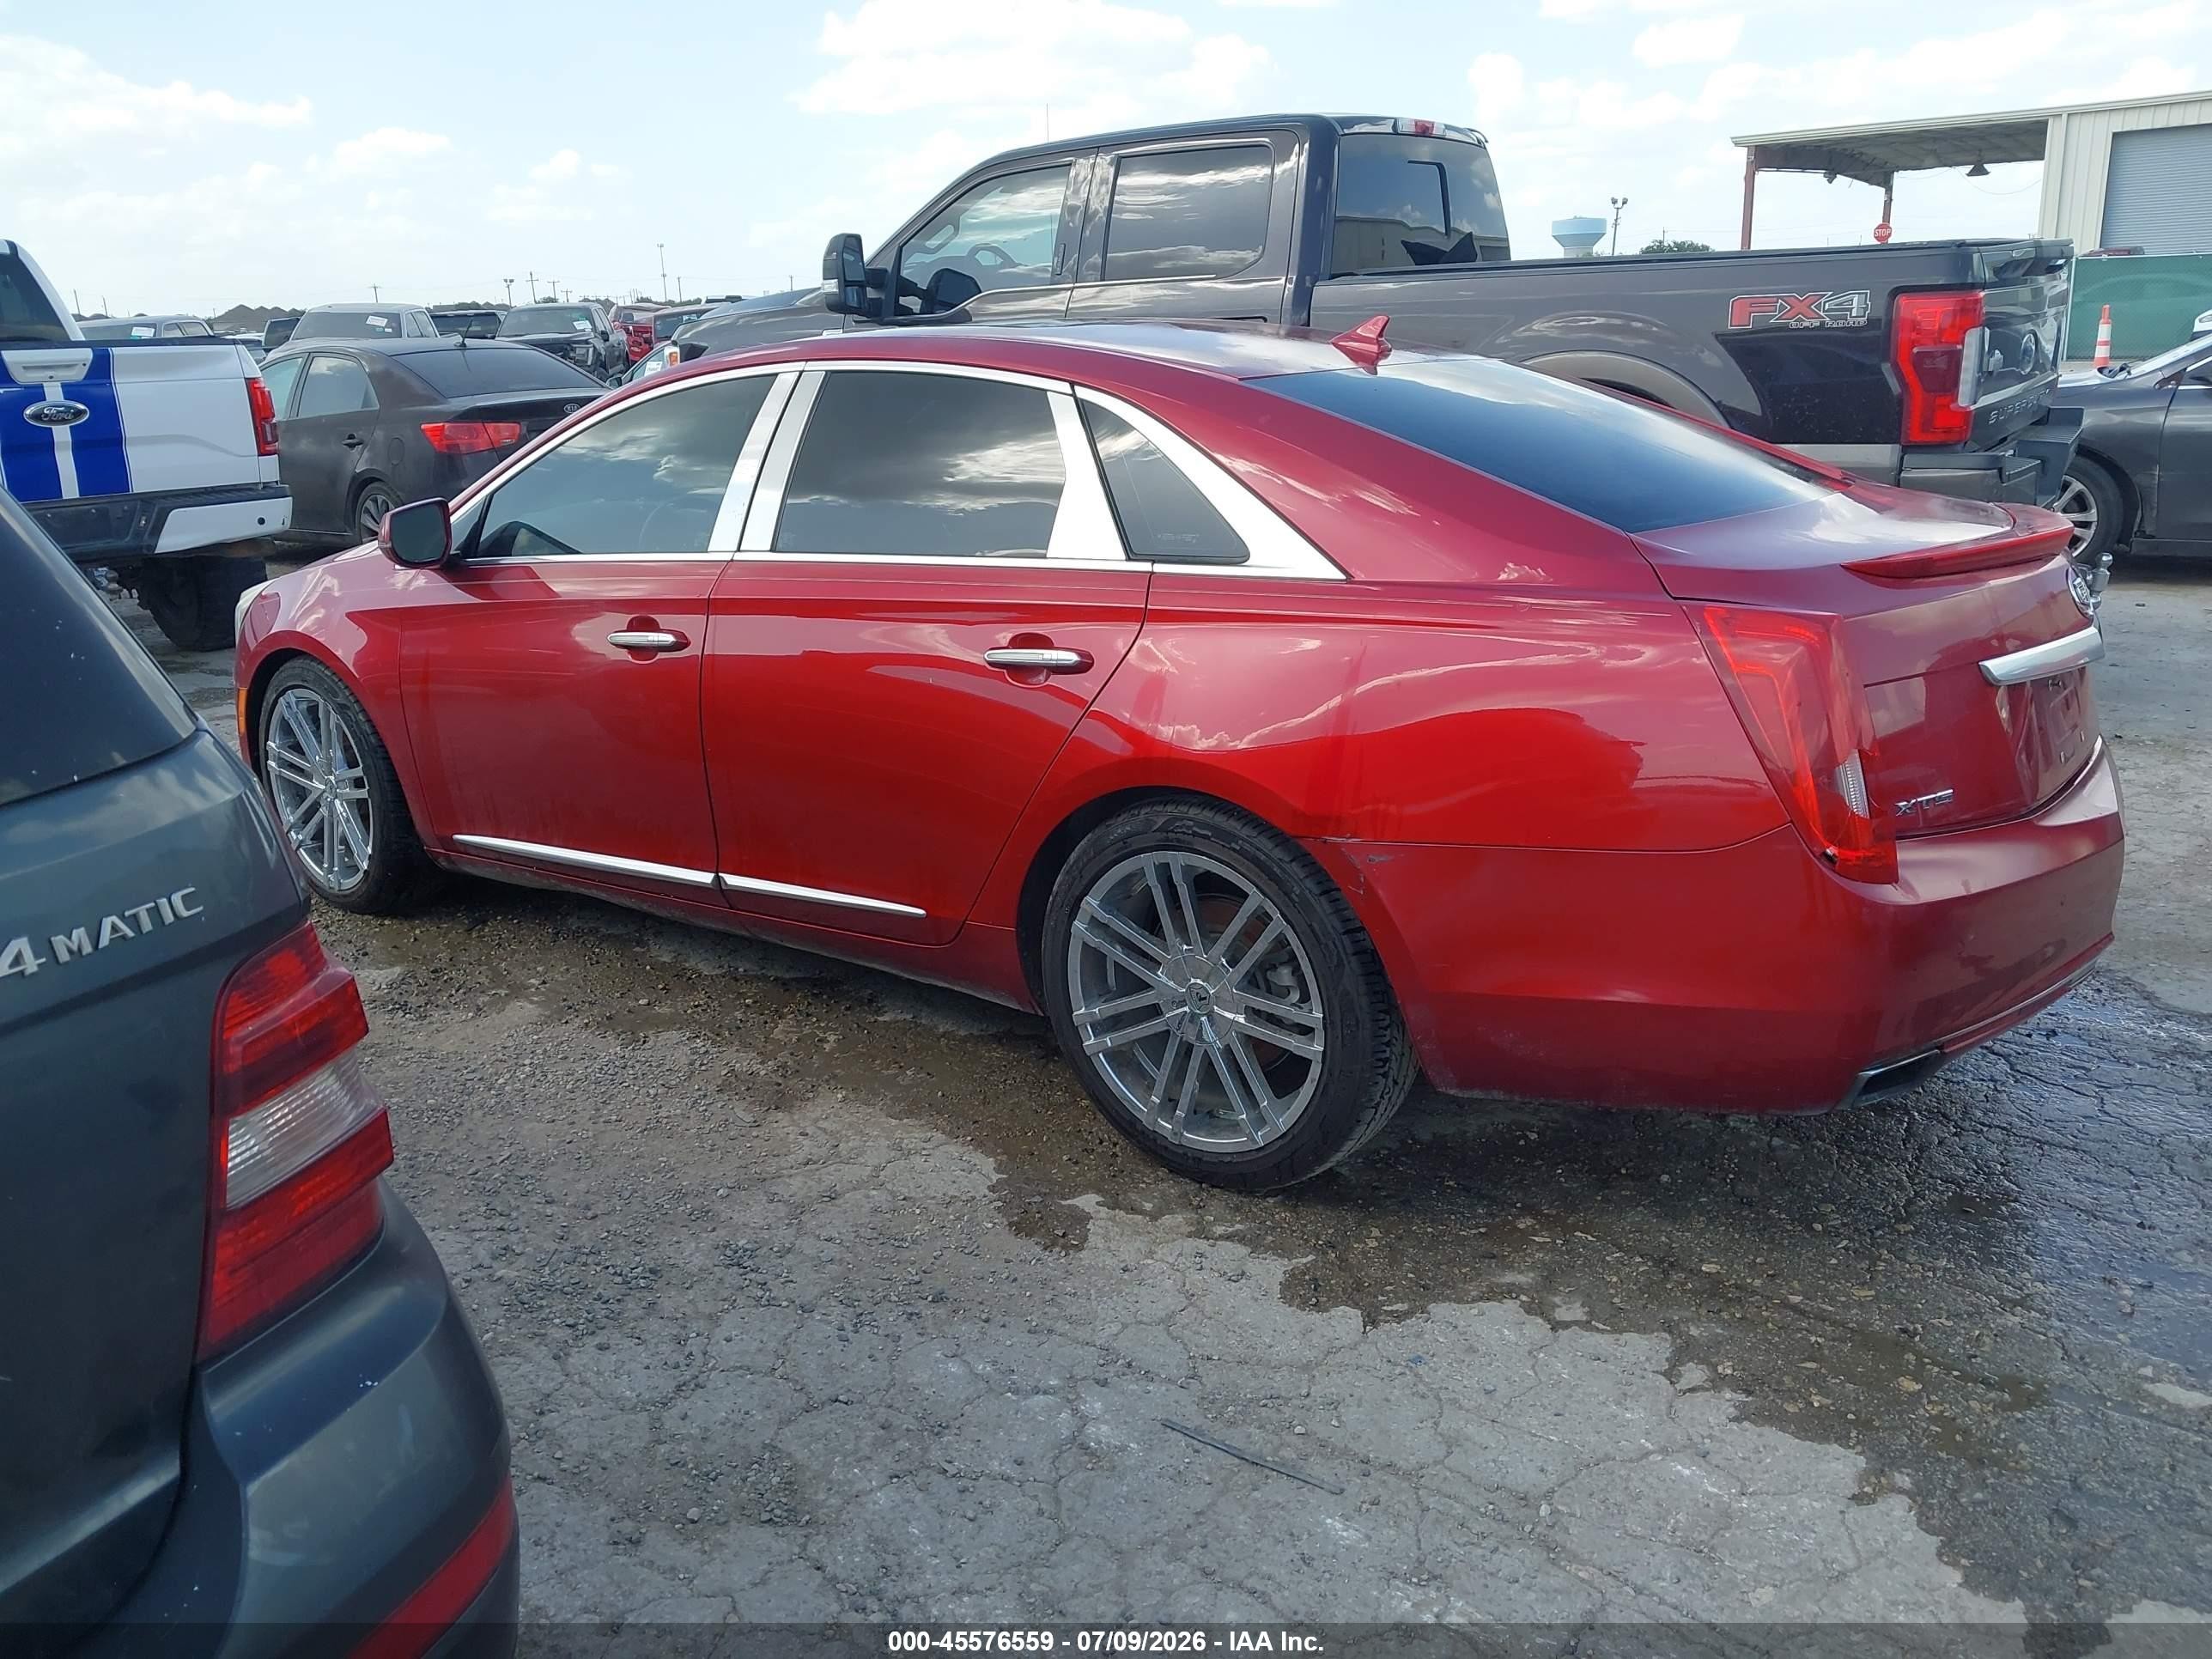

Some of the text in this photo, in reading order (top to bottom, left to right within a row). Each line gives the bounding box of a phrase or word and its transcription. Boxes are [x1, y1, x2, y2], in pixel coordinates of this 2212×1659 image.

[1875, 228, 1891, 237] STOP
[1728, 290, 1871, 329] FX4
[1789, 319, 1868, 329] OFF ROAD
[41, 406, 74, 421] Ford
[1894, 789, 1954, 817] XTS
